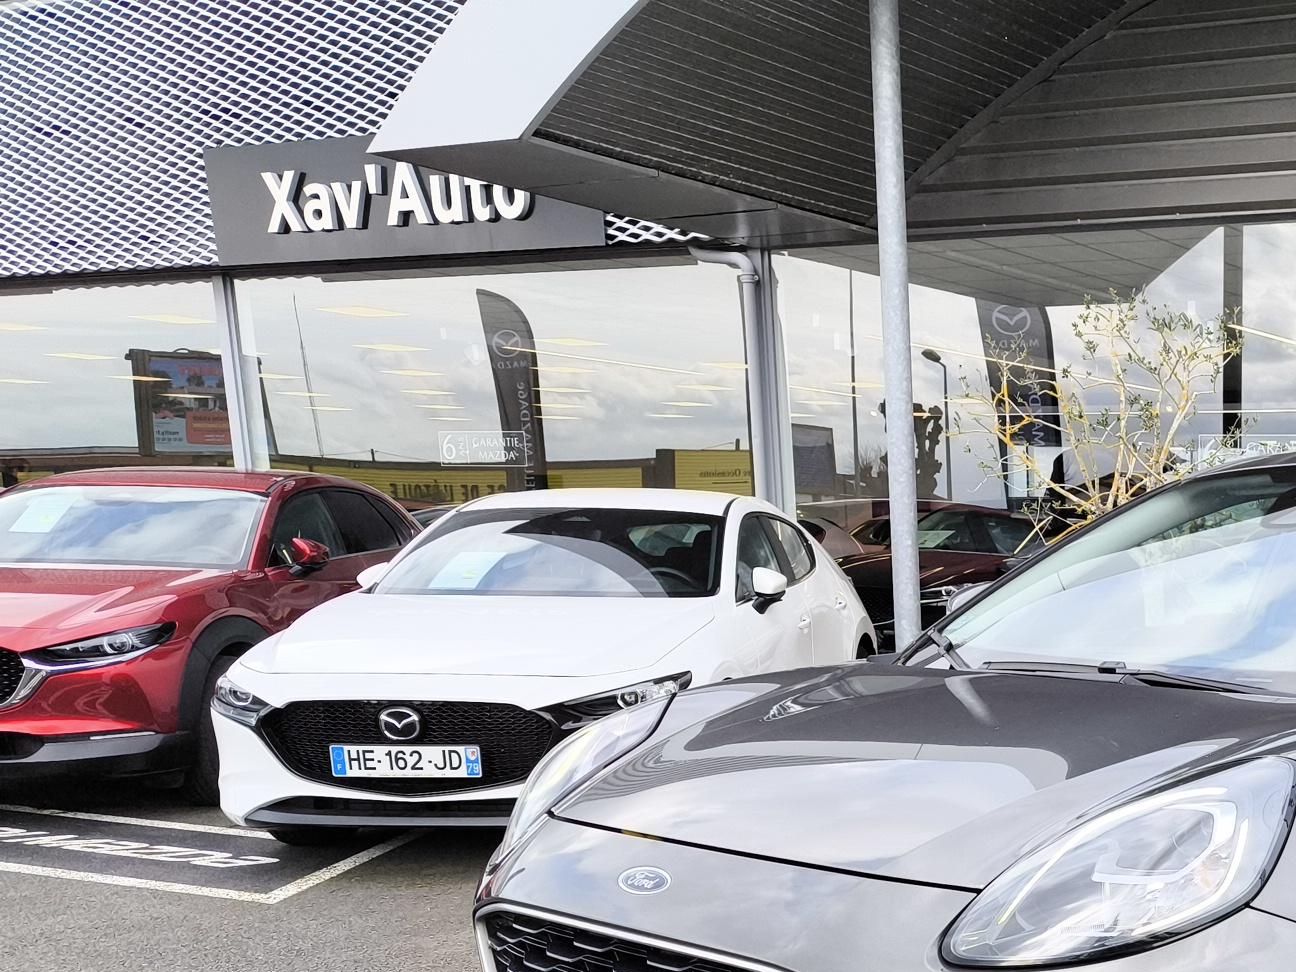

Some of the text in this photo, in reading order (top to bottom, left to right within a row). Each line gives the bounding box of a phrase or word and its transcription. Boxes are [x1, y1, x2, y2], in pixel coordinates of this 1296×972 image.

[260, 161, 531, 234] Xav'Auto
[443, 434, 456, 459] 6
[472, 437, 519, 449] GARANTIE
[479, 450, 516, 461] MAZDA
[467, 763, 479, 774] 79
[627, 871, 660, 889] Ford
